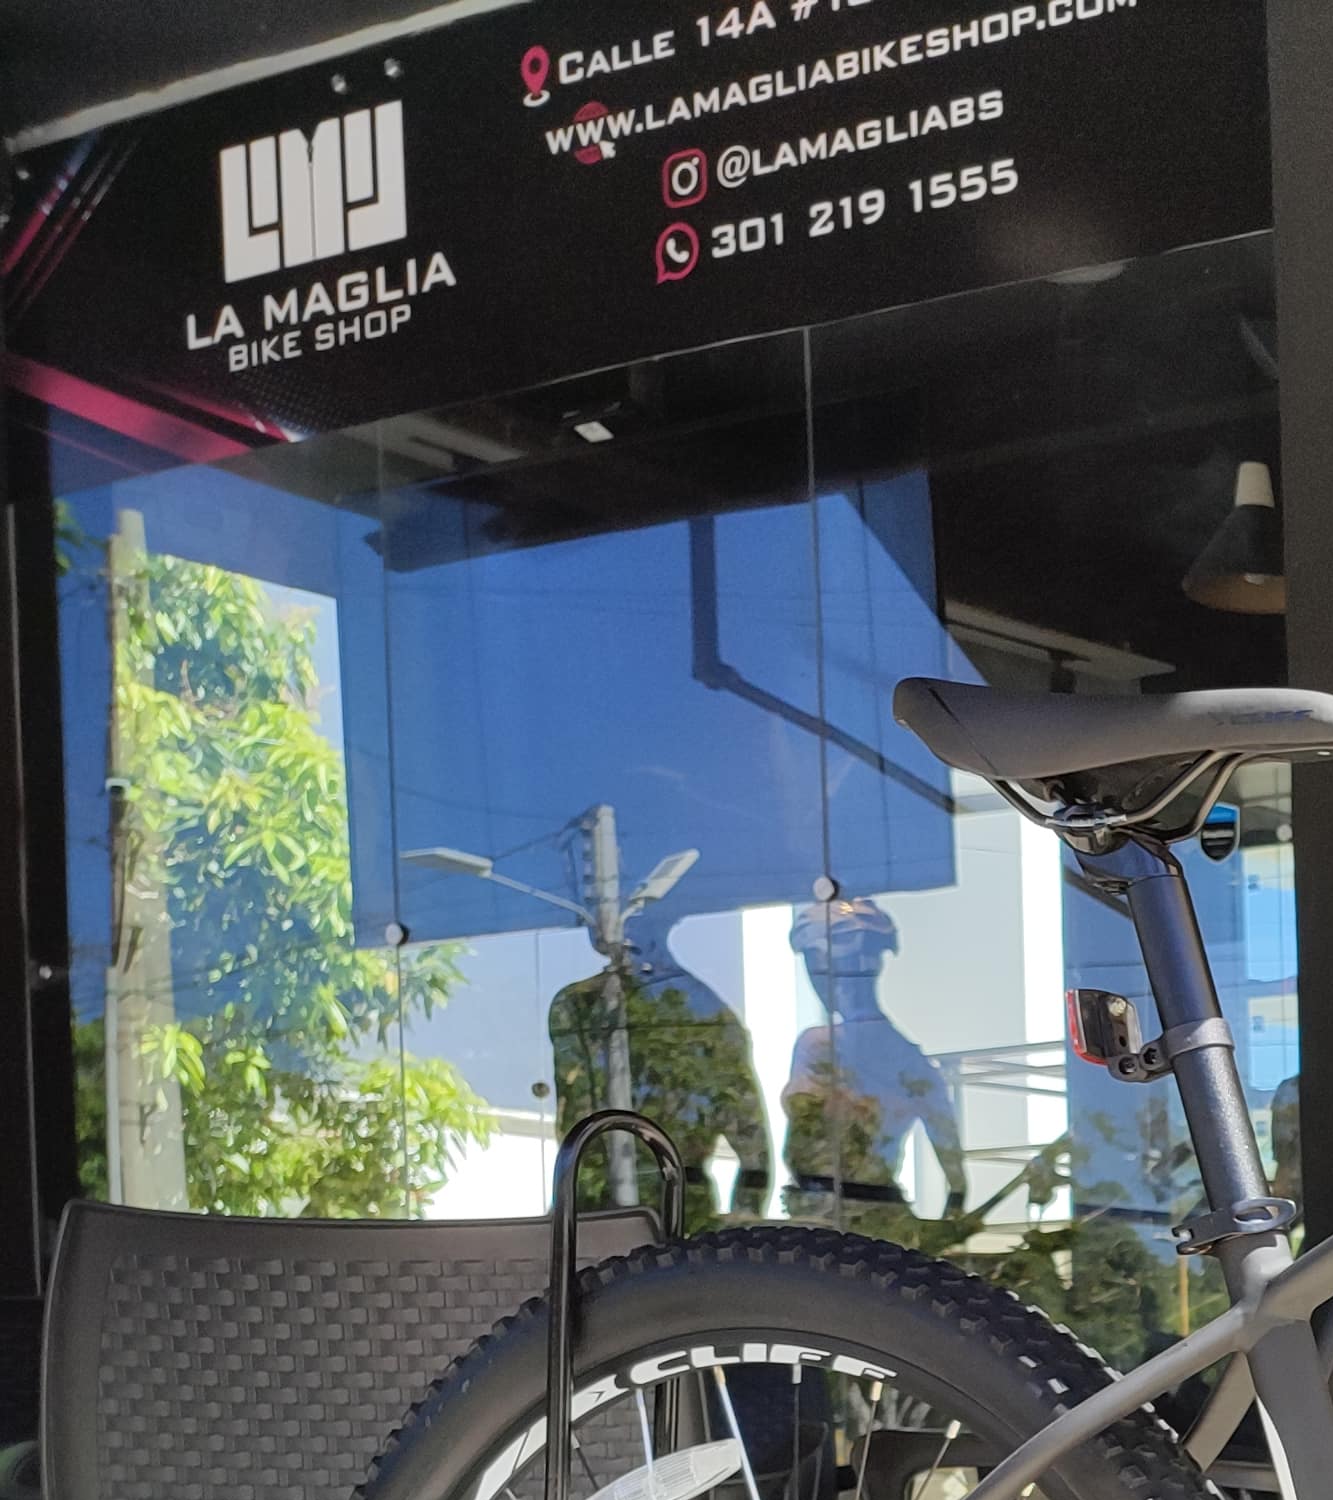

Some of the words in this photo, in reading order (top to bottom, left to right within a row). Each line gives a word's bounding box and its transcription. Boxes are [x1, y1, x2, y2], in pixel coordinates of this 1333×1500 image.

[558, 30, 675, 84] CALLE
[696, 1, 777, 47] 14A
[716, 90, 1003, 188] @LAMAGLIABS
[711, 212, 784, 258] 301
[808, 188, 885, 237] 219
[908, 158, 1018, 213] 1555
[186, 304, 244, 350] LA
[263, 251, 457, 331] MAGLIA
[228, 330, 302, 372] BIKE
[314, 303, 411, 351] SHOP
[630, 1343, 898, 1384] CLIFF
